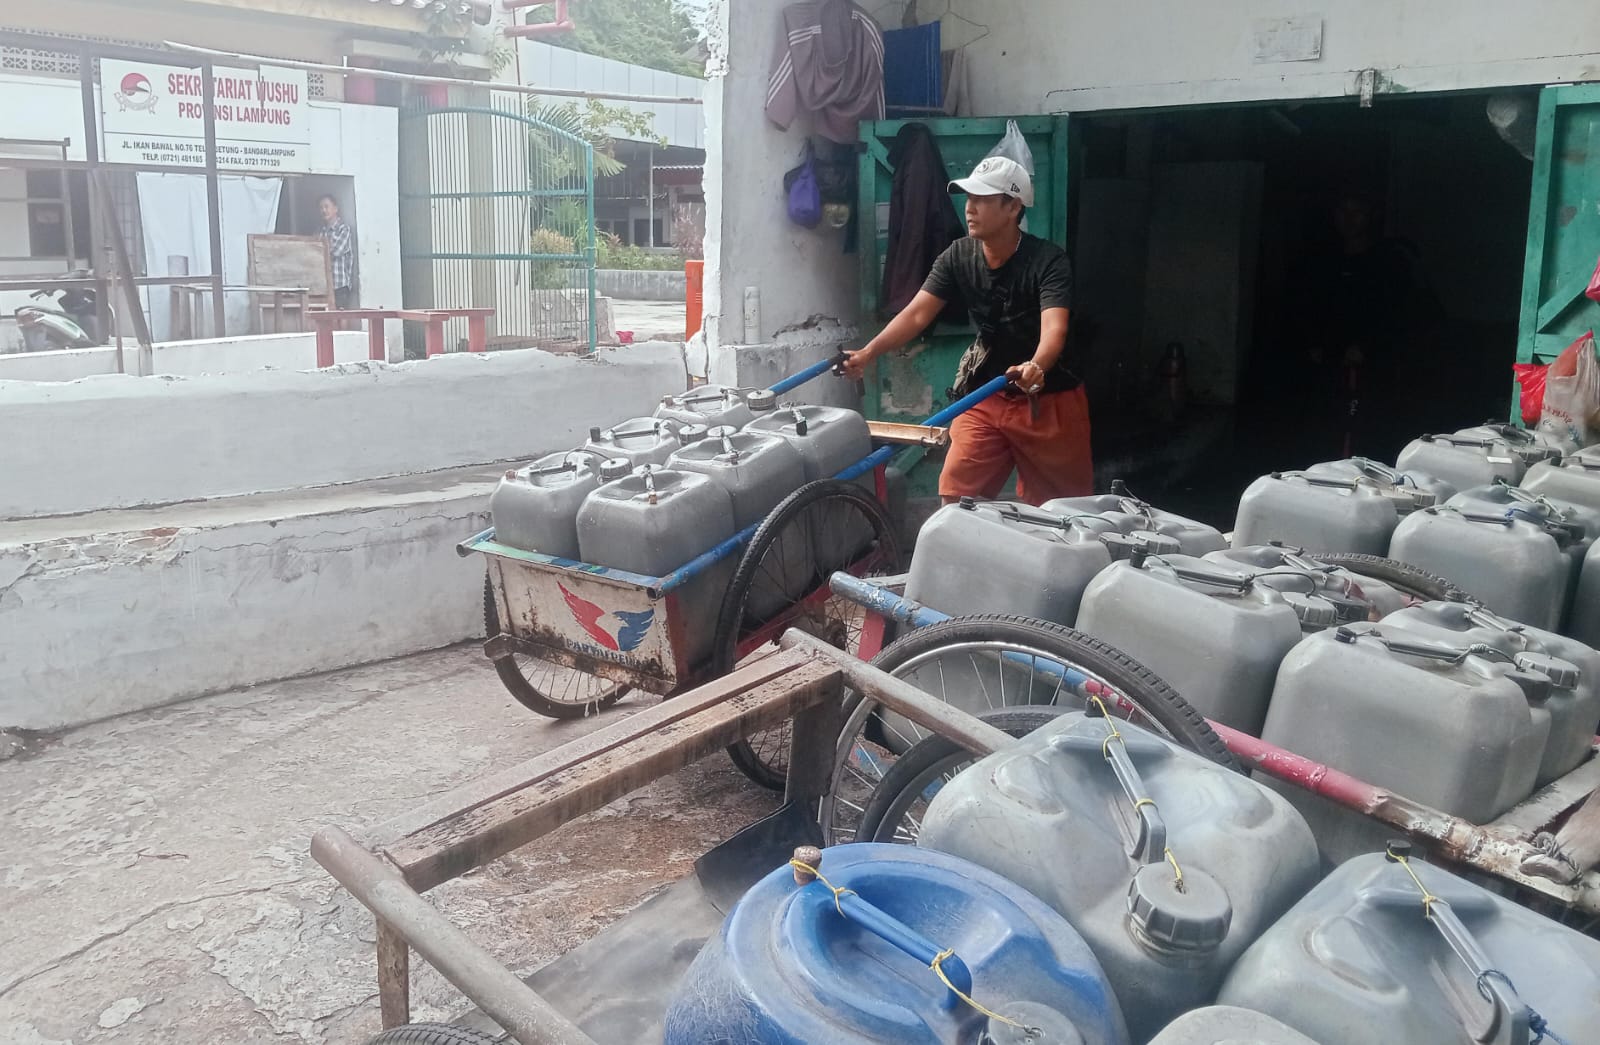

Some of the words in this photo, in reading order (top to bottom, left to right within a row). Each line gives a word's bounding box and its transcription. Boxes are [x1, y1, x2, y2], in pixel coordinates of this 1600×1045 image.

[168, 73, 252, 101] SEKRARIAT
[256, 80, 298, 104] WUSHU
[178, 102, 233, 121] PRONSI
[236, 106, 291, 126] LAMPUNG
[122, 141, 132, 149] JL.
[134, 141, 150, 150] IKAN
[152, 142, 174, 152] BAWAL
